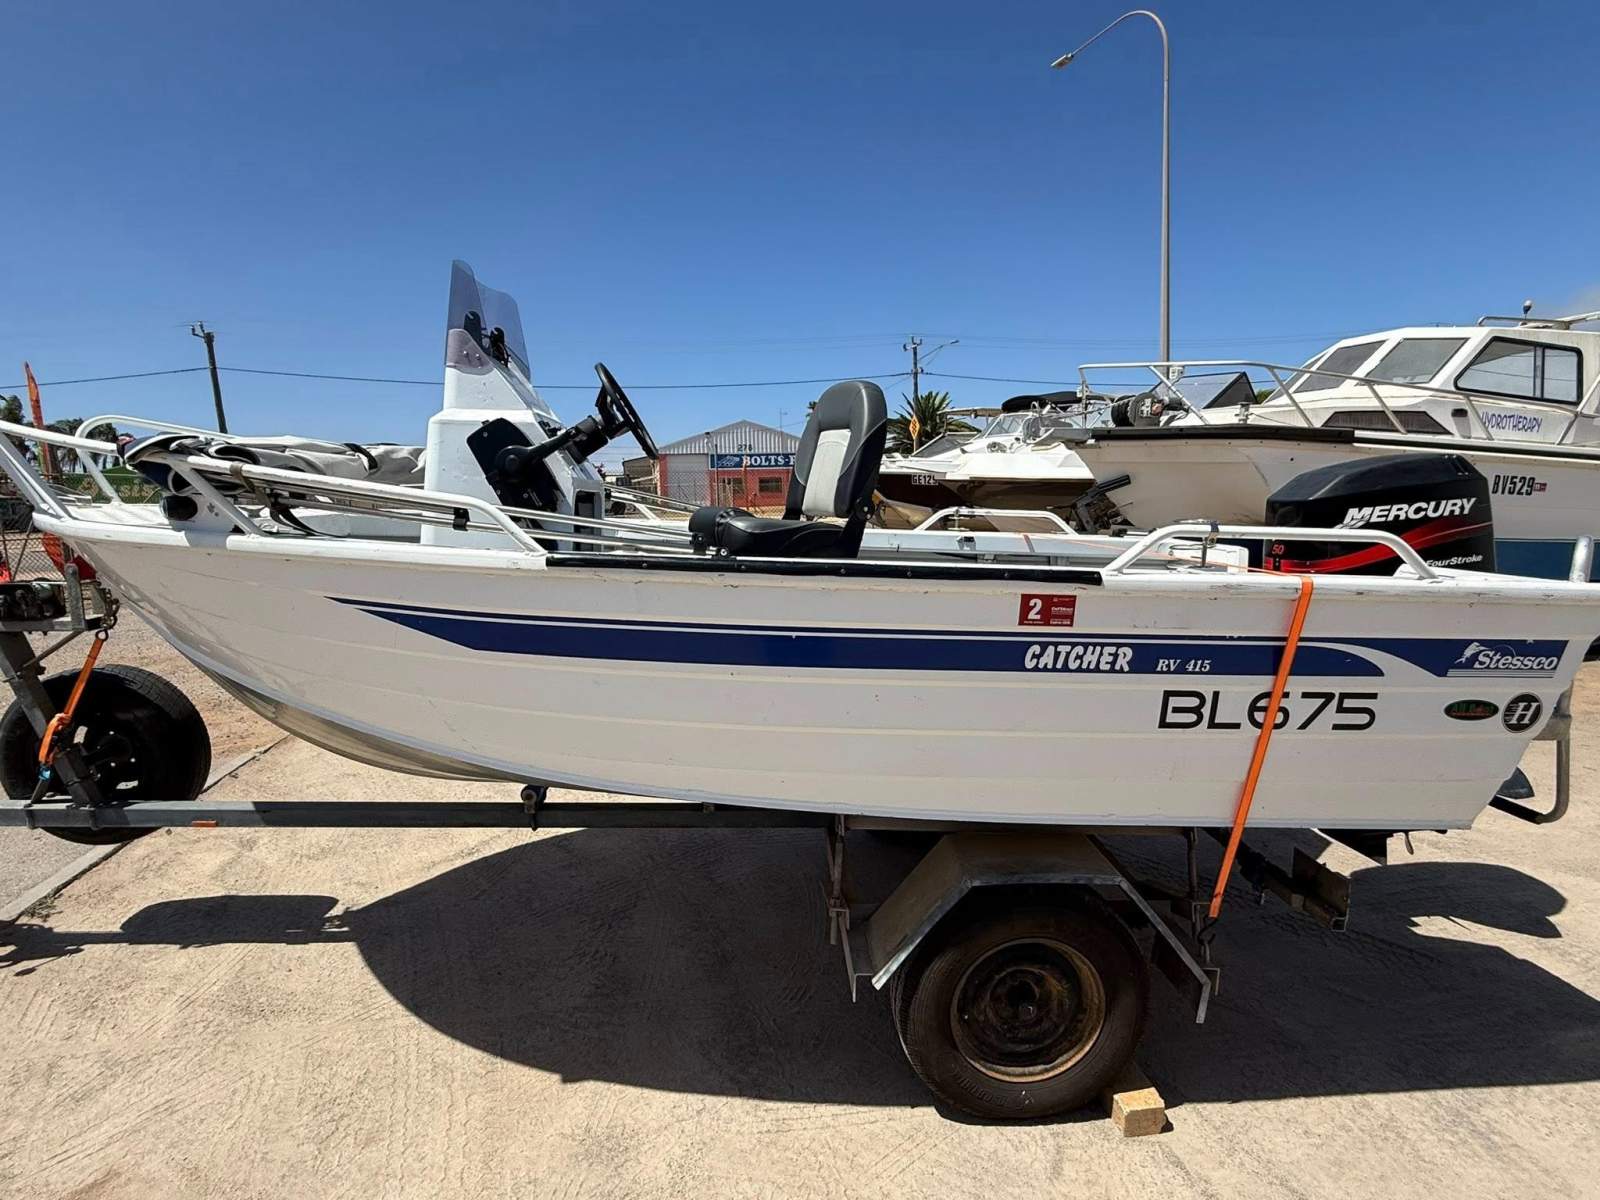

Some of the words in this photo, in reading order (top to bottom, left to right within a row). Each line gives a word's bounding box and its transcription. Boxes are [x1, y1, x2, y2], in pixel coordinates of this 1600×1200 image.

[1481, 411, 1542, 432] HYDROTHERAPY
[1491, 474, 1535, 496] BV529
[1342, 498, 1477, 523] MERCURY
[1271, 543, 1285, 555] 50
[1425, 554, 1483, 567] FourStroke
[1027, 598, 1042, 620] 2
[1024, 644, 1133, 672] CATCHER
[1156, 659, 1181, 672] RV
[1185, 659, 1212, 672] 415
[1473, 650, 1558, 670] Stessco
[1158, 690, 1379, 731] BL675
